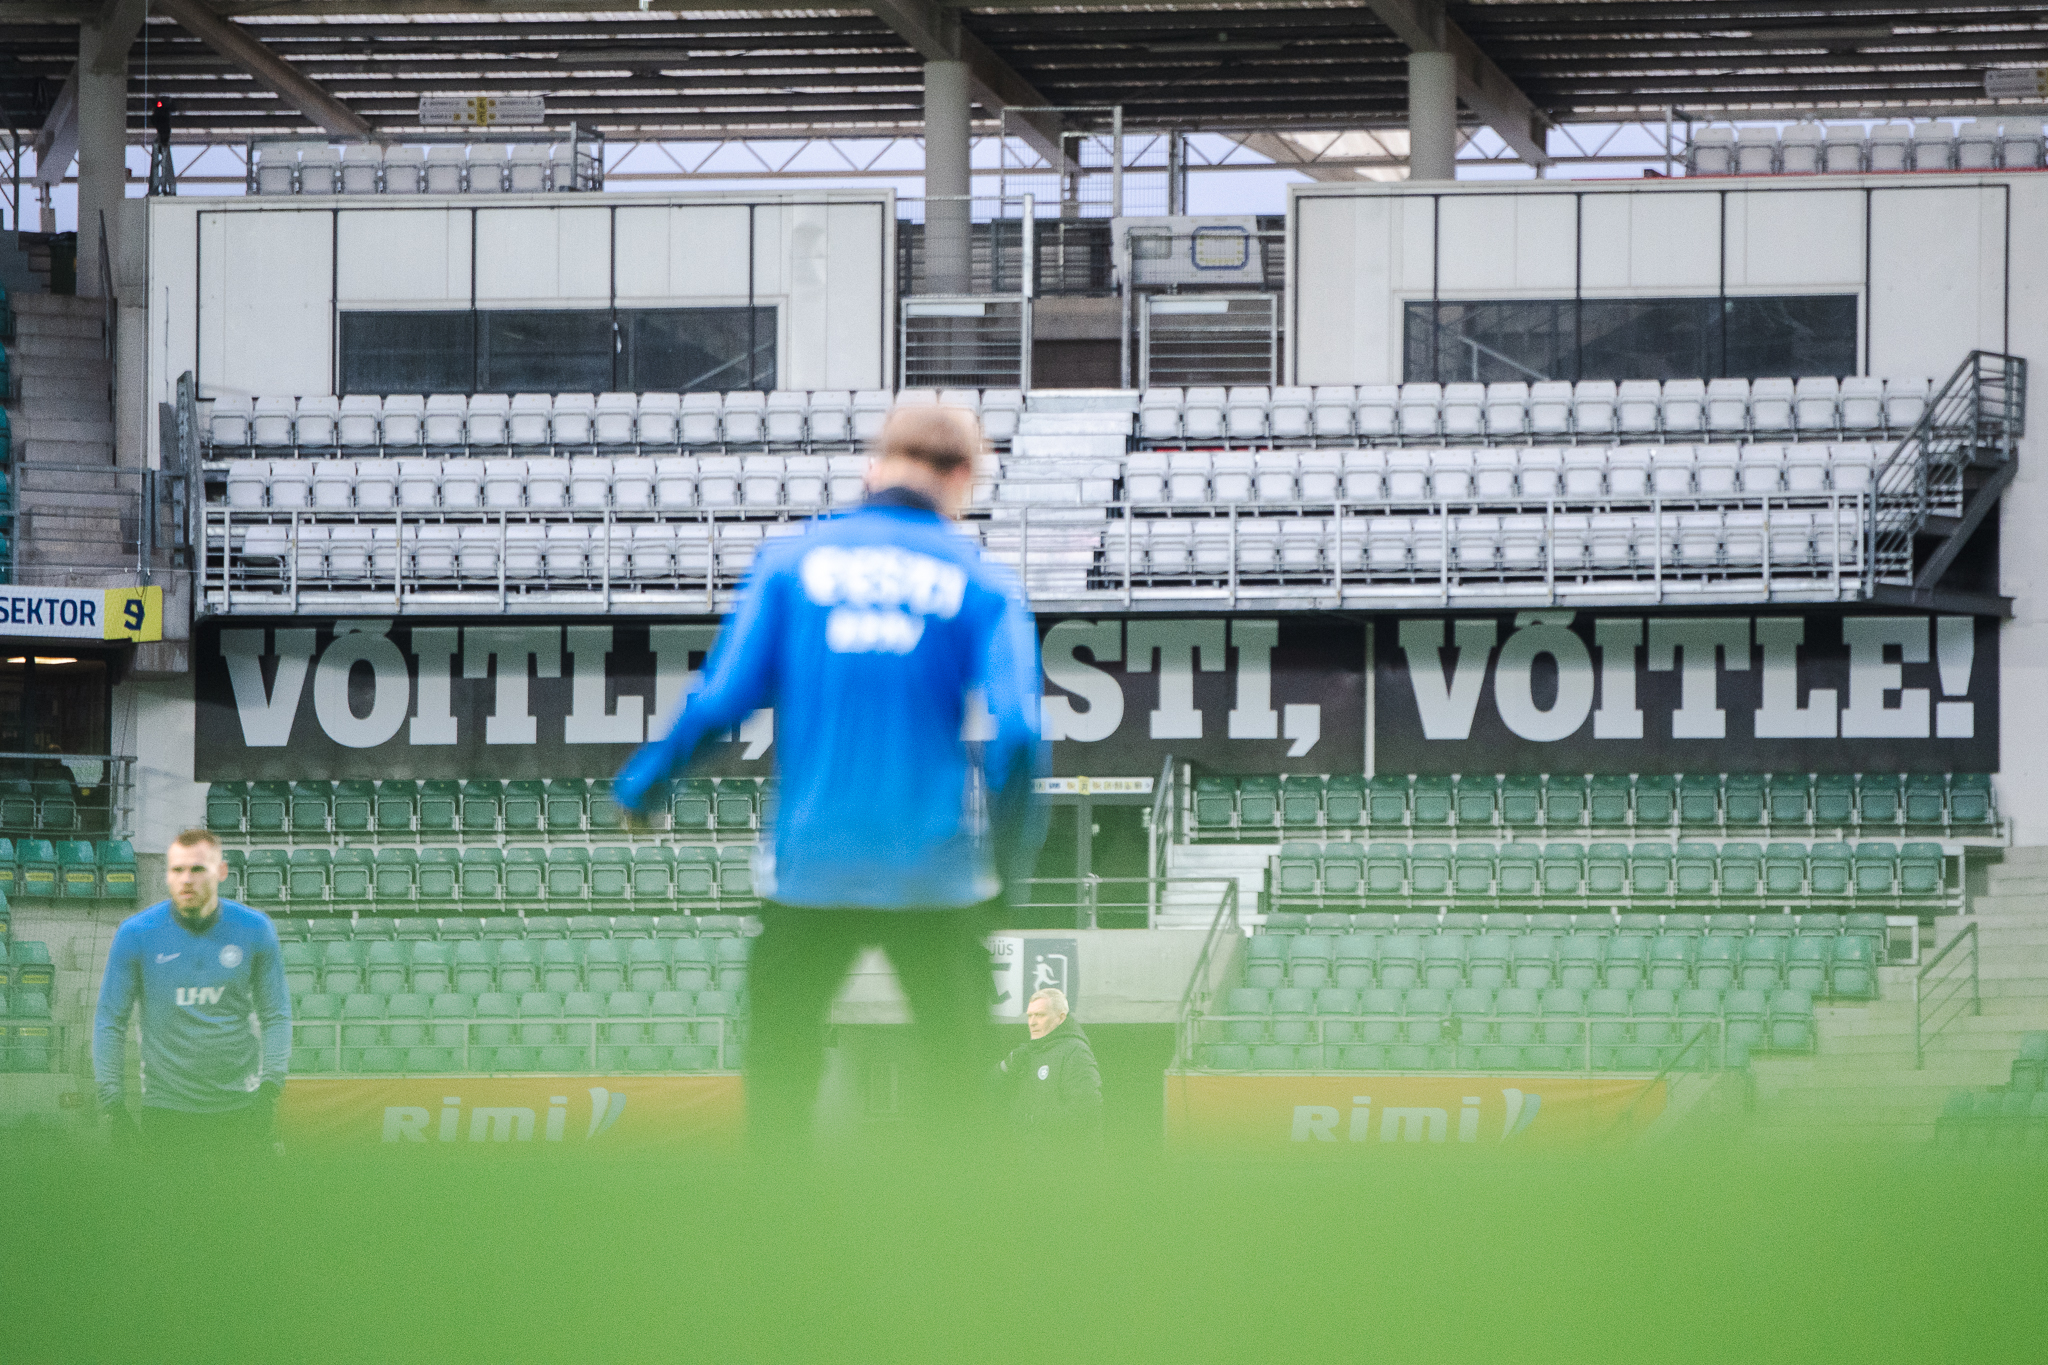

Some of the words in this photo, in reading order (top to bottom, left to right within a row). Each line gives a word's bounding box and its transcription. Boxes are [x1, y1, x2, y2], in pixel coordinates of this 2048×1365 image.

[0, 596, 96, 627] SEKTOR
[123, 598, 145, 631] 9
[960, 618, 1321, 757] STI,
[1398, 610, 1975, 743] VÕITLE!
[175, 986, 225, 1006] LHV
